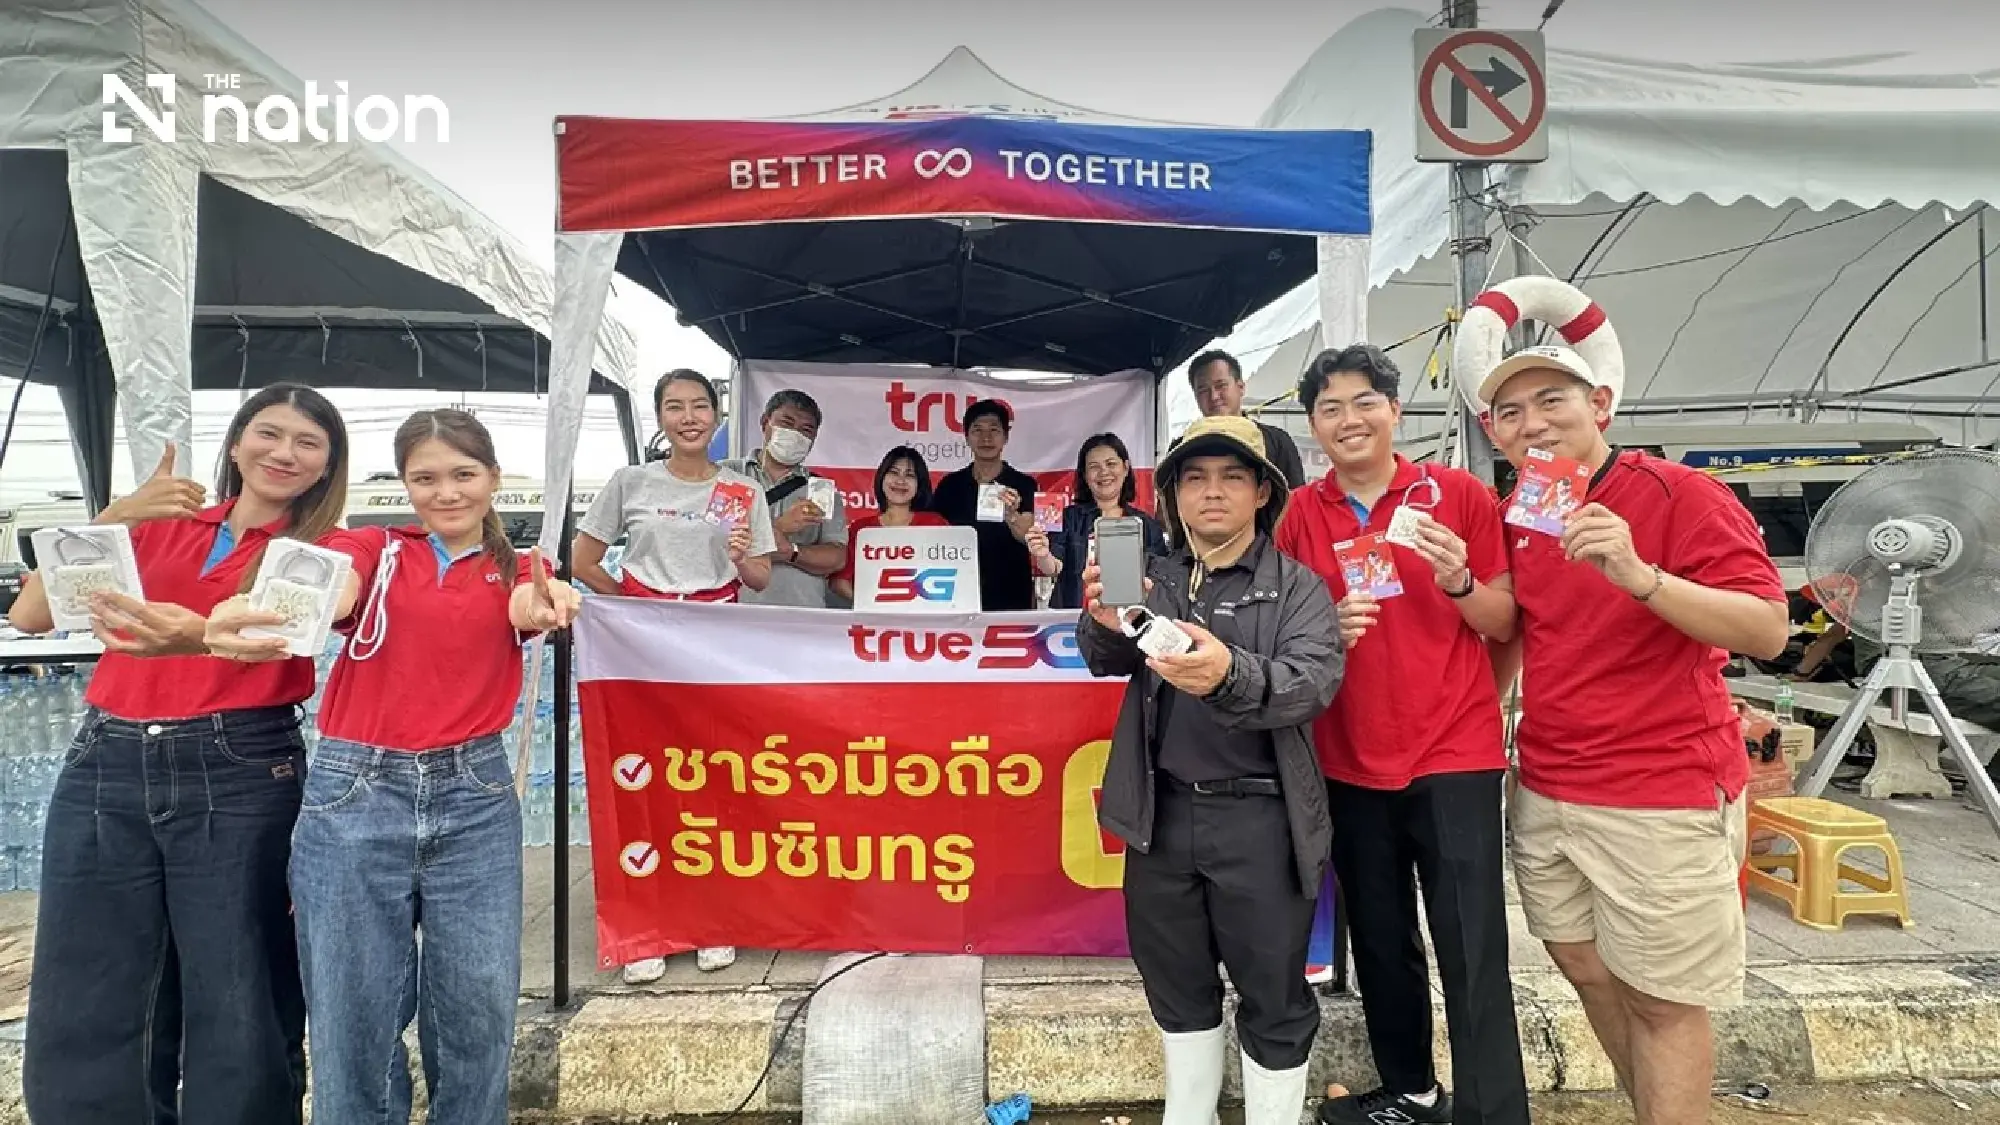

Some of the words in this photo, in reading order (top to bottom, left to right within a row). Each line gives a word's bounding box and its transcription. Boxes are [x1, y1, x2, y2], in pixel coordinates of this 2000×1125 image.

[729, 153, 888, 190] BETTER
[998, 149, 1213, 192] TOGETHER
[861, 543, 916, 561] true
[927, 543, 972, 561] dtac
[873, 567, 958, 603] 5G
[847, 624, 973, 663] true
[663, 734, 1044, 798] ชาร์จมือถือ
[669, 811, 977, 904] รับซิมทรู
